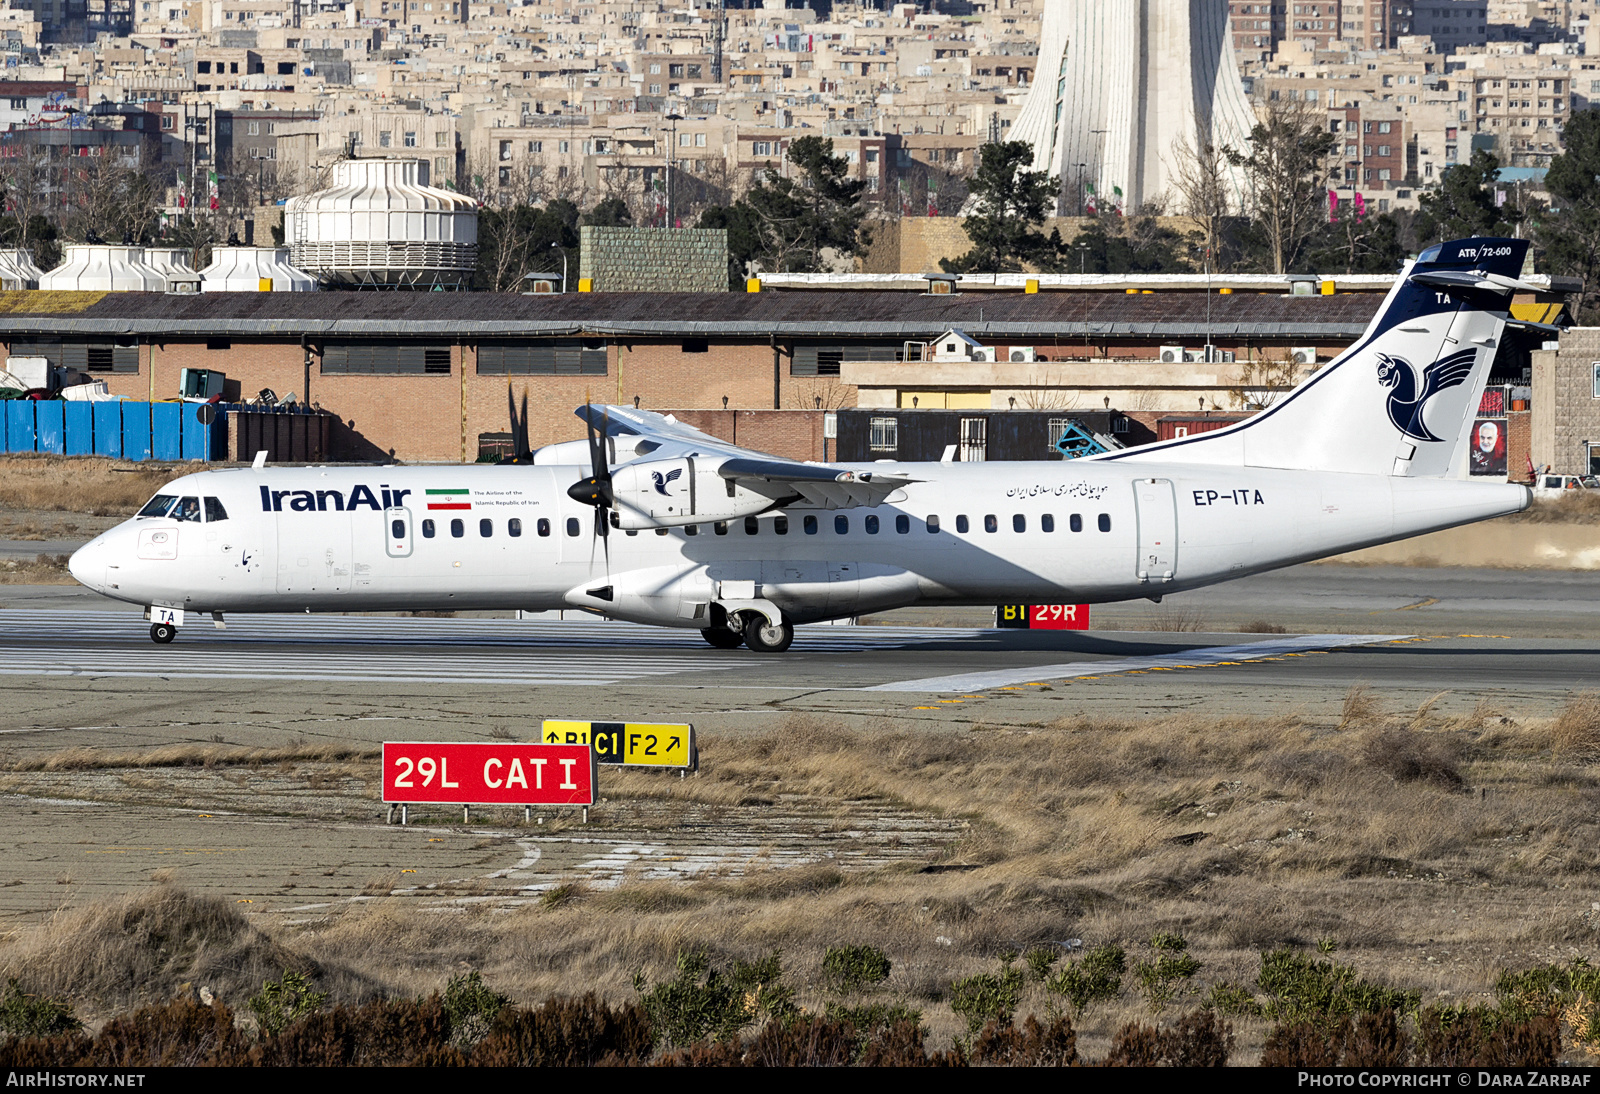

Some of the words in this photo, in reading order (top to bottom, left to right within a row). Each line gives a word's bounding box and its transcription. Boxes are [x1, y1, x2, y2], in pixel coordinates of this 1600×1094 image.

[1435, 292, 1451, 304] TA
[259, 484, 412, 512] IranAir
[1006, 486, 1028, 500] ایران
[1028, 484, 1053, 497] اسلامی
[1192, 489, 1265, 506] EP-ITA
[160, 610, 175, 622] TA
[1035, 605, 1077, 621] 29R
[594, 732, 618, 755] C1
[629, 733, 658, 756] F2
[394, 756, 459, 788] 29L
[483, 757, 548, 790] CAT
[559, 758, 577, 790] I
